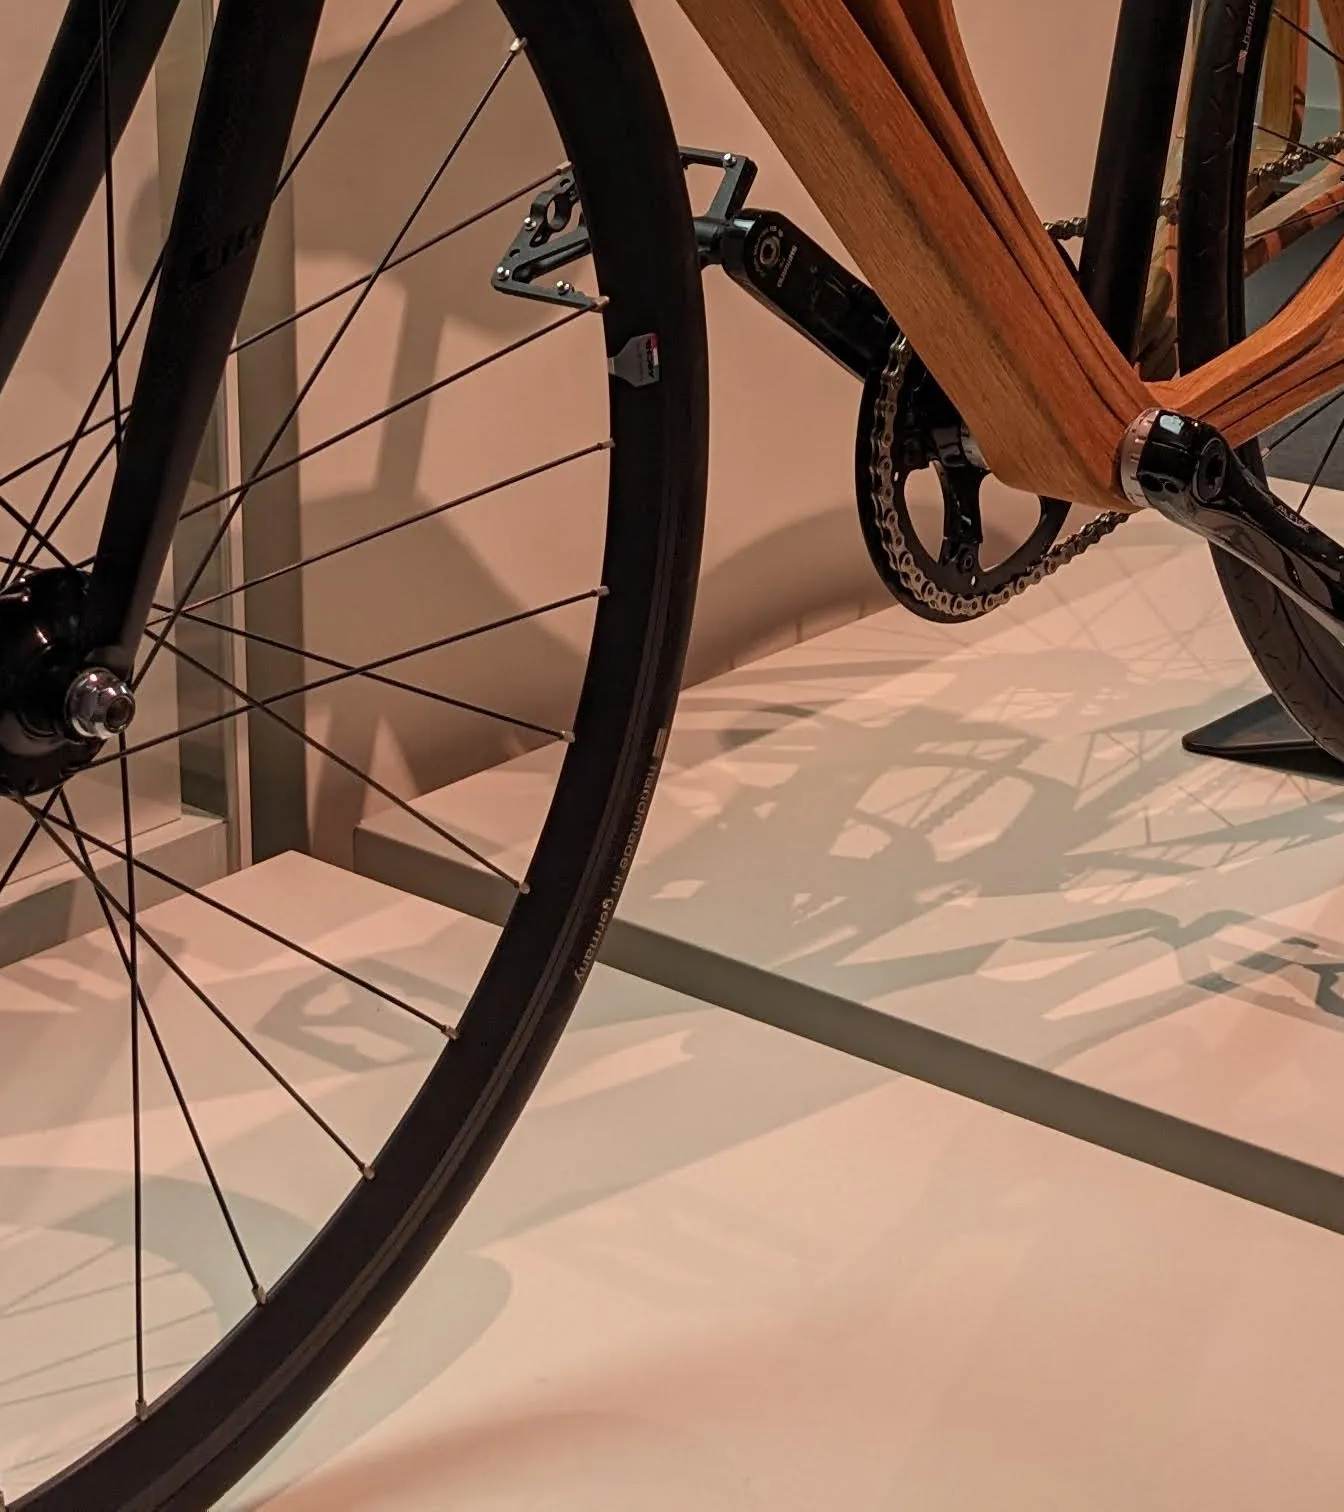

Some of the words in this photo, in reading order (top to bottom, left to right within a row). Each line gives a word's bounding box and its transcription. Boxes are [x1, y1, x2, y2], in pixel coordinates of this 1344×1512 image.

[618, 763, 658, 871] handmade
[610, 874, 623, 895] in
[574, 897, 614, 985] germany
